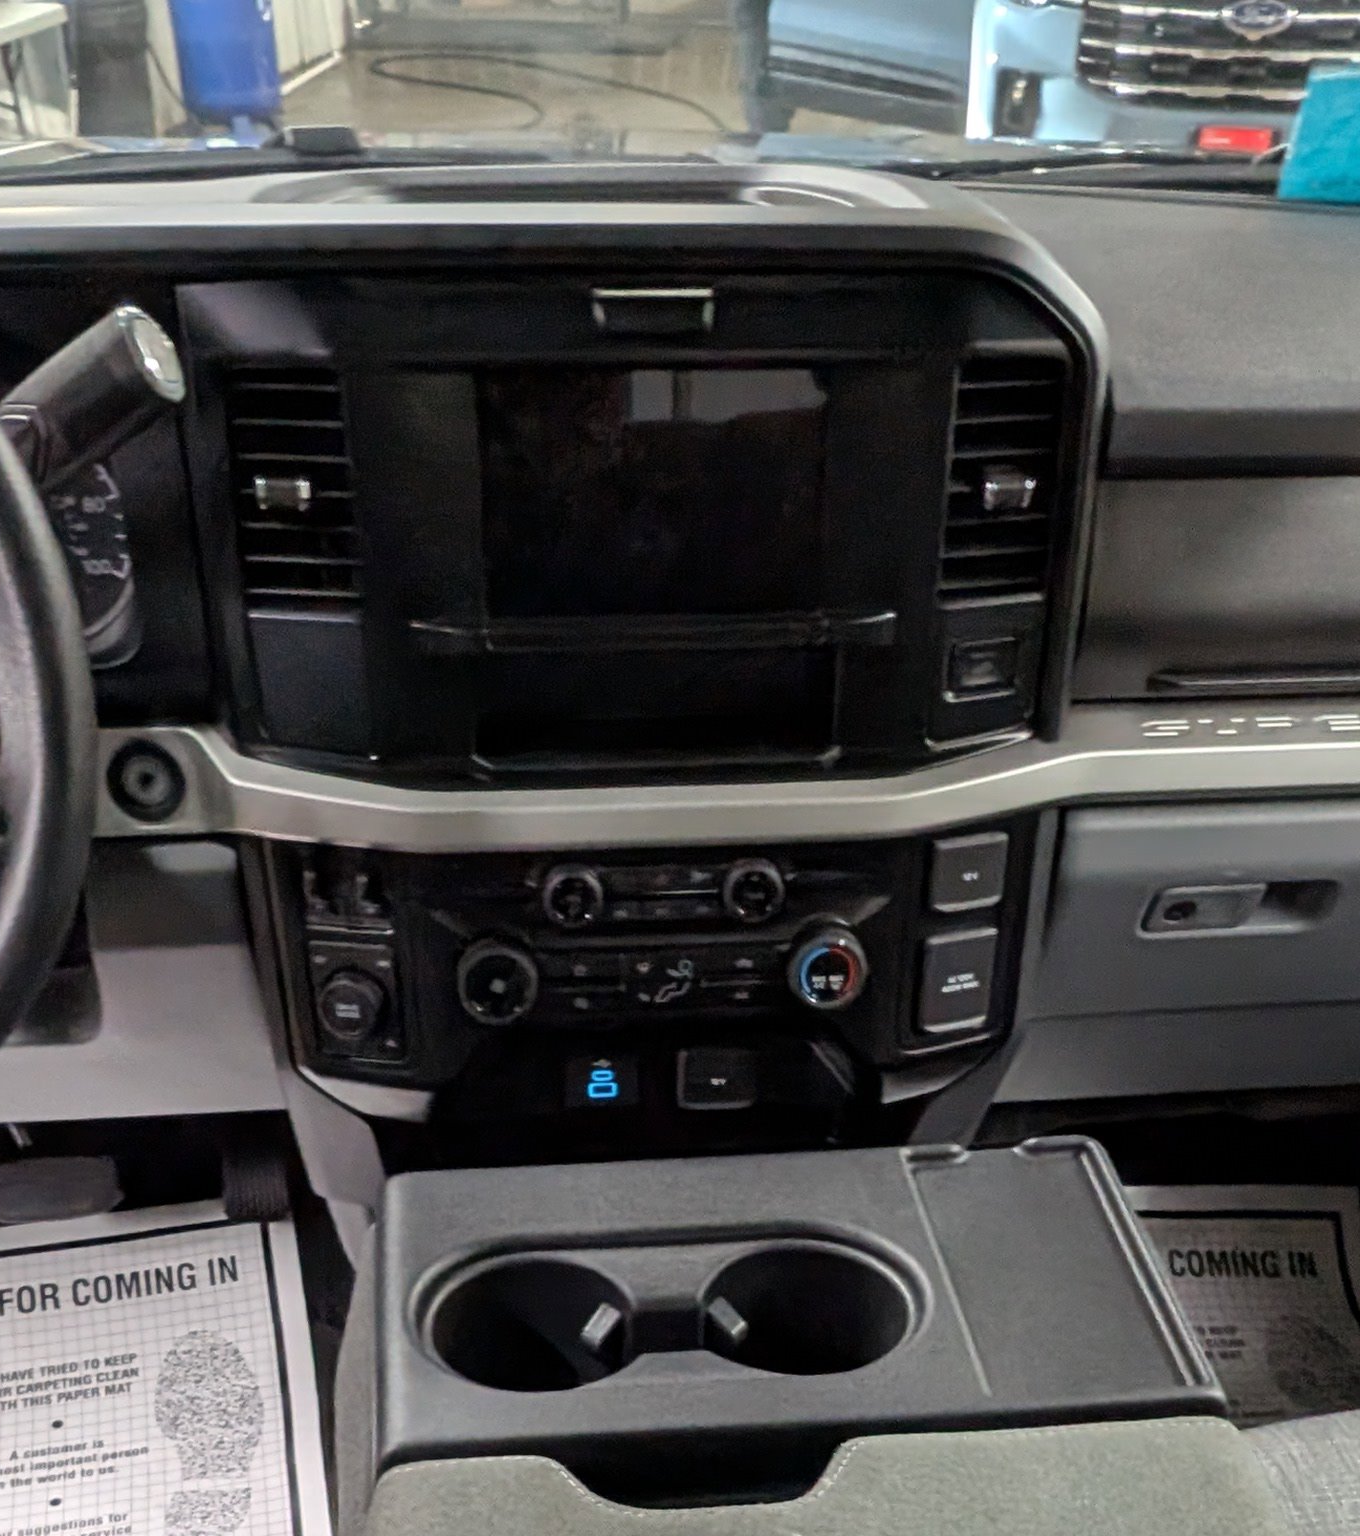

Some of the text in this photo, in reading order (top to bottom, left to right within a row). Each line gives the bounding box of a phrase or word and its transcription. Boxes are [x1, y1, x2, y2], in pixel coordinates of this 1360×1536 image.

[1168, 1248, 1319, 1279] COMING IN
[72, 1262, 197, 1306] COMING
[208, 1254, 240, 1286] IN
[0, 1367, 35, 1383] HAVE
[39, 1361, 79, 1377] TRIED
[83, 1358, 100, 1370] TO
[103, 1353, 138, 1367] KEEP
[16, 1374, 93, 1396] CARPETING
[96, 1367, 140, 1383] CLEAN
[22, 1394, 52, 1409] THIS
[56, 1387, 100, 1403] PAPER
[104, 1381, 133, 1396] MAT
[9, 1439, 105, 1461] A customer is
[30, 1453, 97, 1473] important
[101, 1446, 150, 1463] person
[10, 1475, 33, 1488] the
[37, 1470, 76, 1484] world
[80, 1467, 94, 1478] to
[108, 1513, 129, 1524] for
